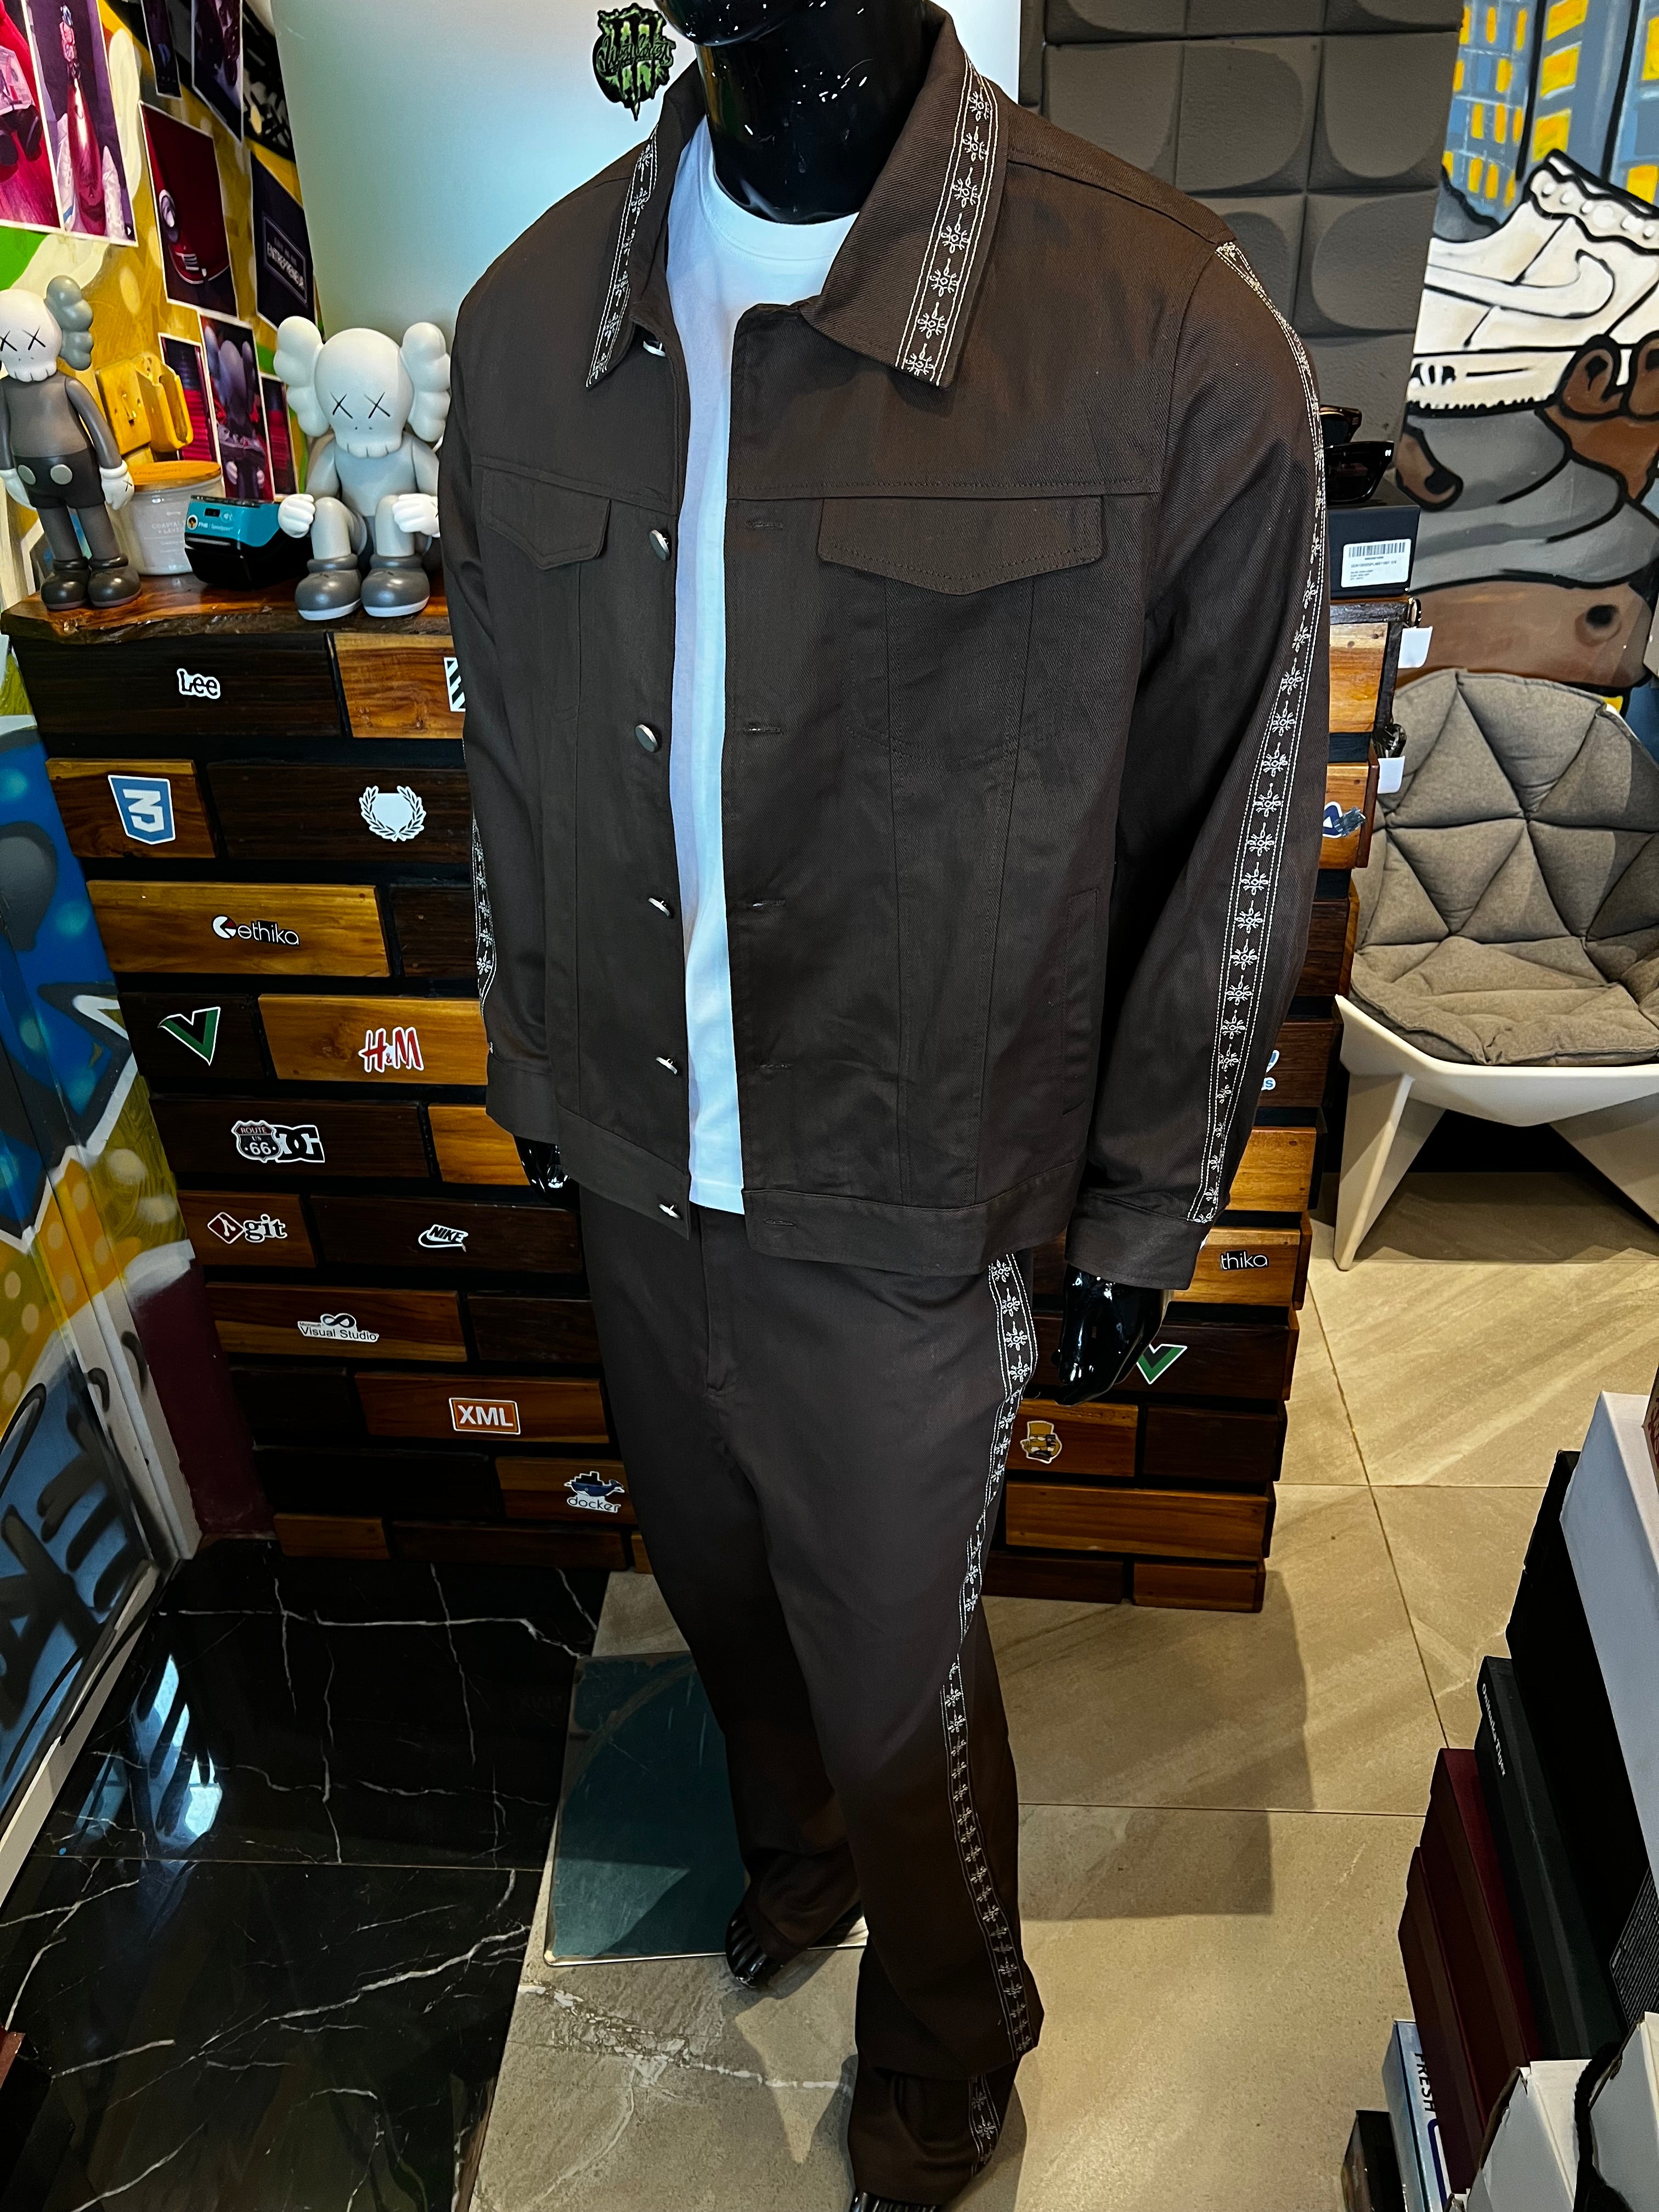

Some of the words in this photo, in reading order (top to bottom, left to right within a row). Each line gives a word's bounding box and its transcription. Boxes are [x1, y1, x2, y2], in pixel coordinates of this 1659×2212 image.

[179, 671, 218, 696] Lee
[122, 788, 165, 833] 3
[238, 921, 300, 945] ethika
[361, 1029, 421, 1070] H&M
[249, 1142, 272, 1155] 66
[244, 1216, 286, 1242] git
[429, 1226, 464, 1243] NIKE
[1221, 1251, 1268, 1270] thika
[301, 1325, 336, 1338] Visual
[340, 1329, 377, 1341] Studio
[458, 1405, 514, 1427] XML
[568, 1496, 620, 1513] docker
[1496, 1738, 1506, 1778] Tiger
